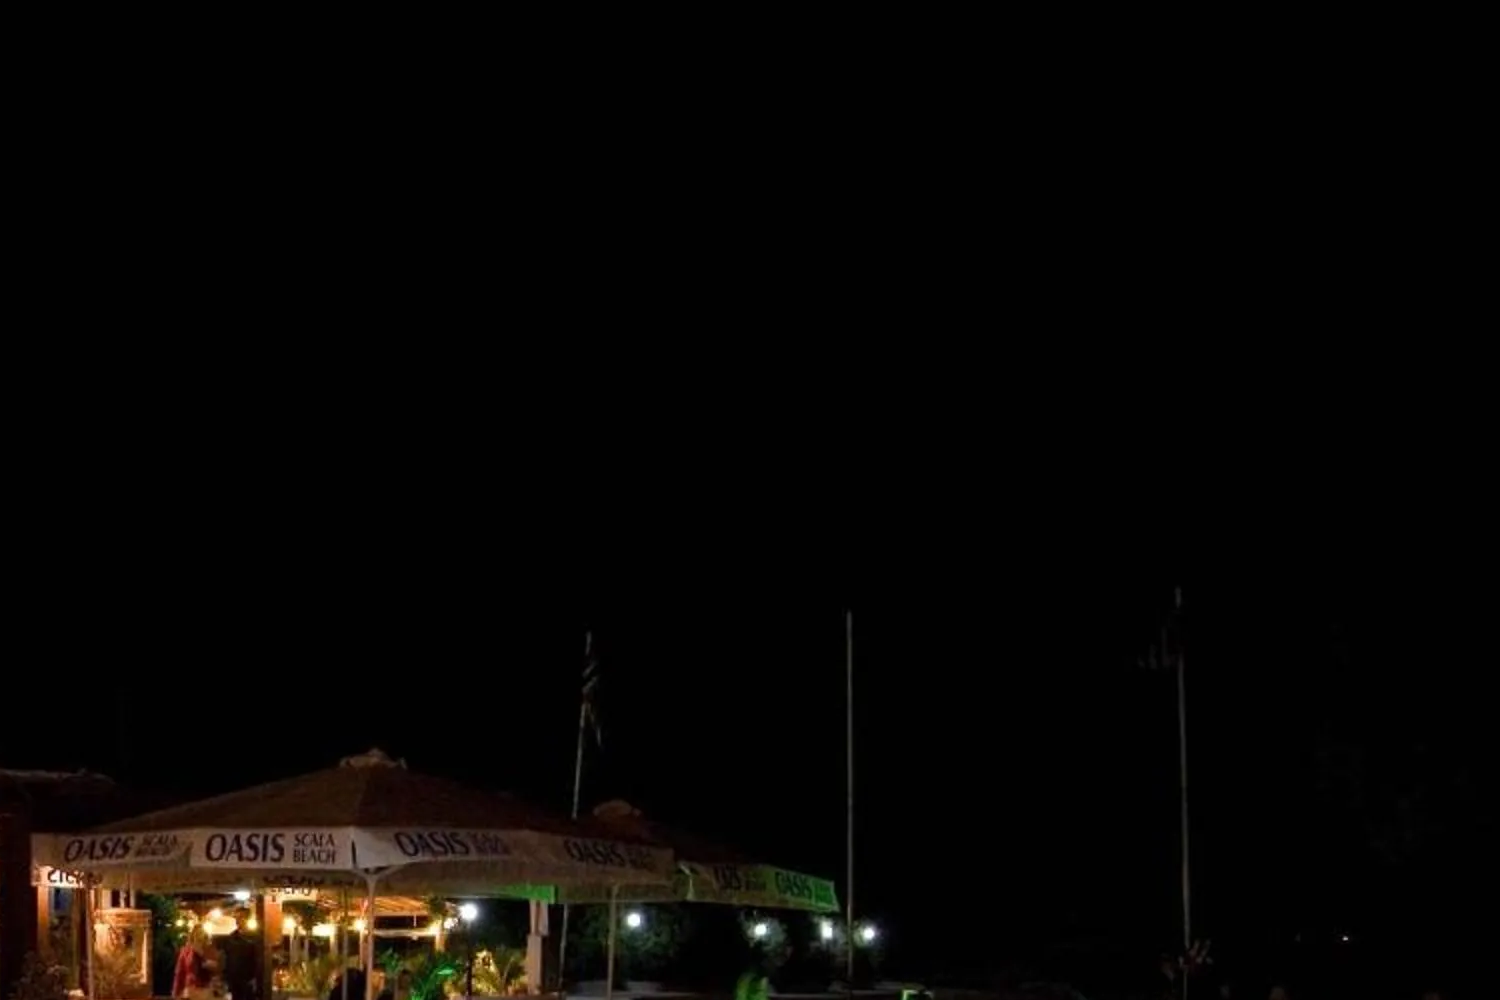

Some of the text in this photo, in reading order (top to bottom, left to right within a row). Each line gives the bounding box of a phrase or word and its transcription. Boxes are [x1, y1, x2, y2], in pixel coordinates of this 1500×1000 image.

[64, 835, 134, 863] OASIS
[205, 833, 285, 863] OASIS
[294, 833, 335, 847] SCALA
[395, 831, 469, 857] OASIS
[292, 848, 336, 864] BEACH
